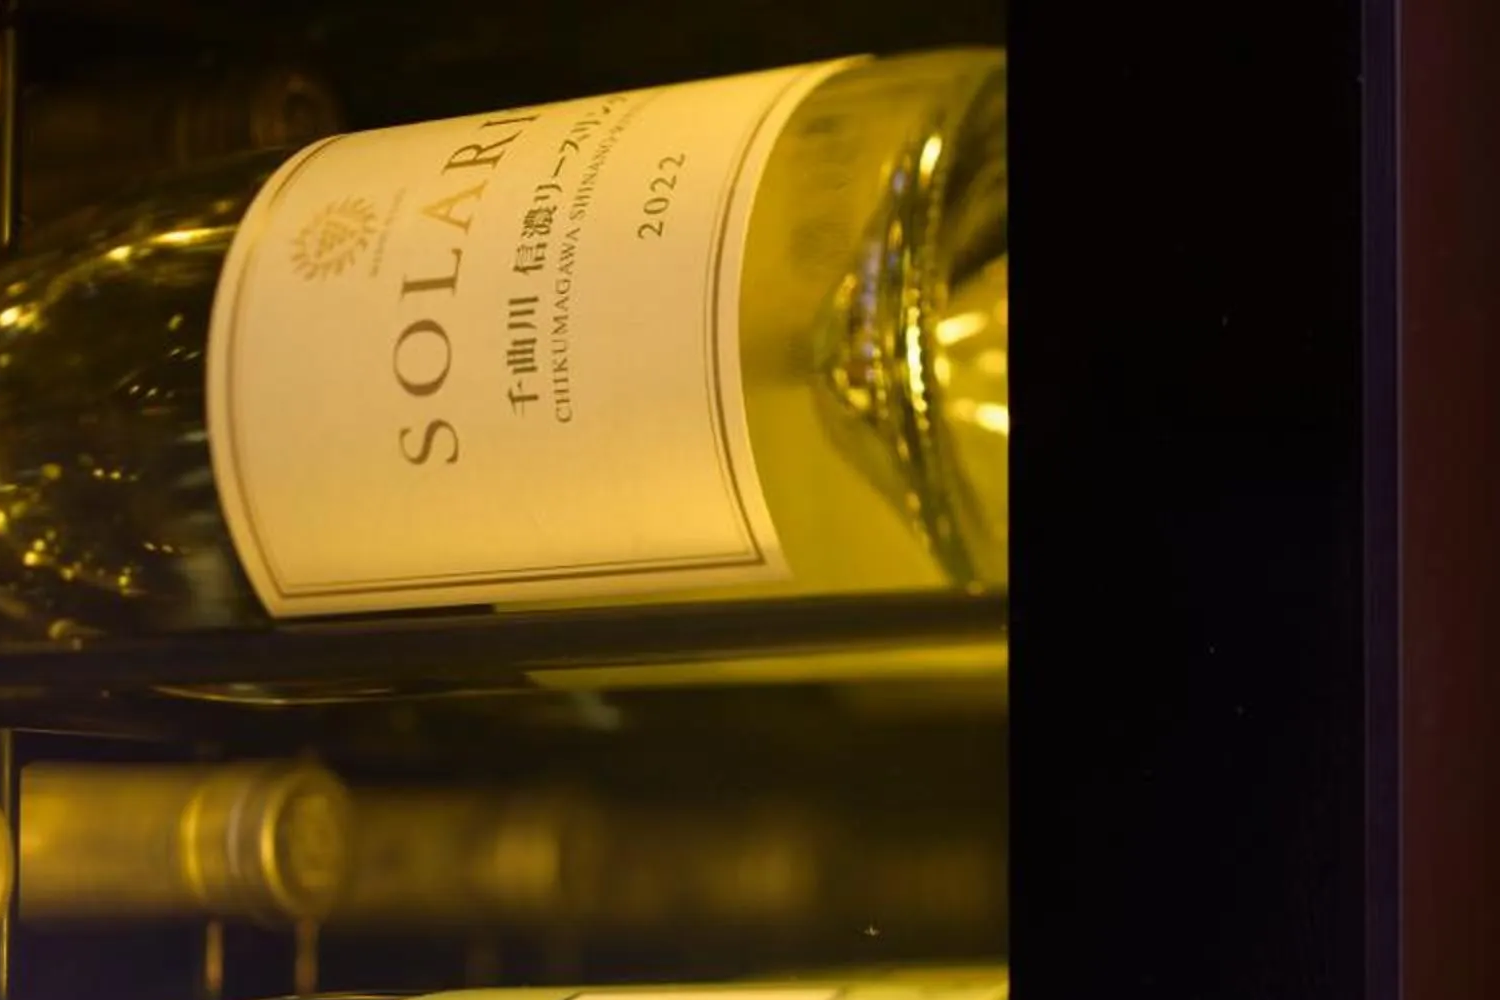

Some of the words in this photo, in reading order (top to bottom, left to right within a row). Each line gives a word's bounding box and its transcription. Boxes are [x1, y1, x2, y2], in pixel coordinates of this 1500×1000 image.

[637, 152, 686, 240] 2022
[507, 296, 540, 416] 千曲川
[551, 227, 581, 424] CHIKUMAGAWA
